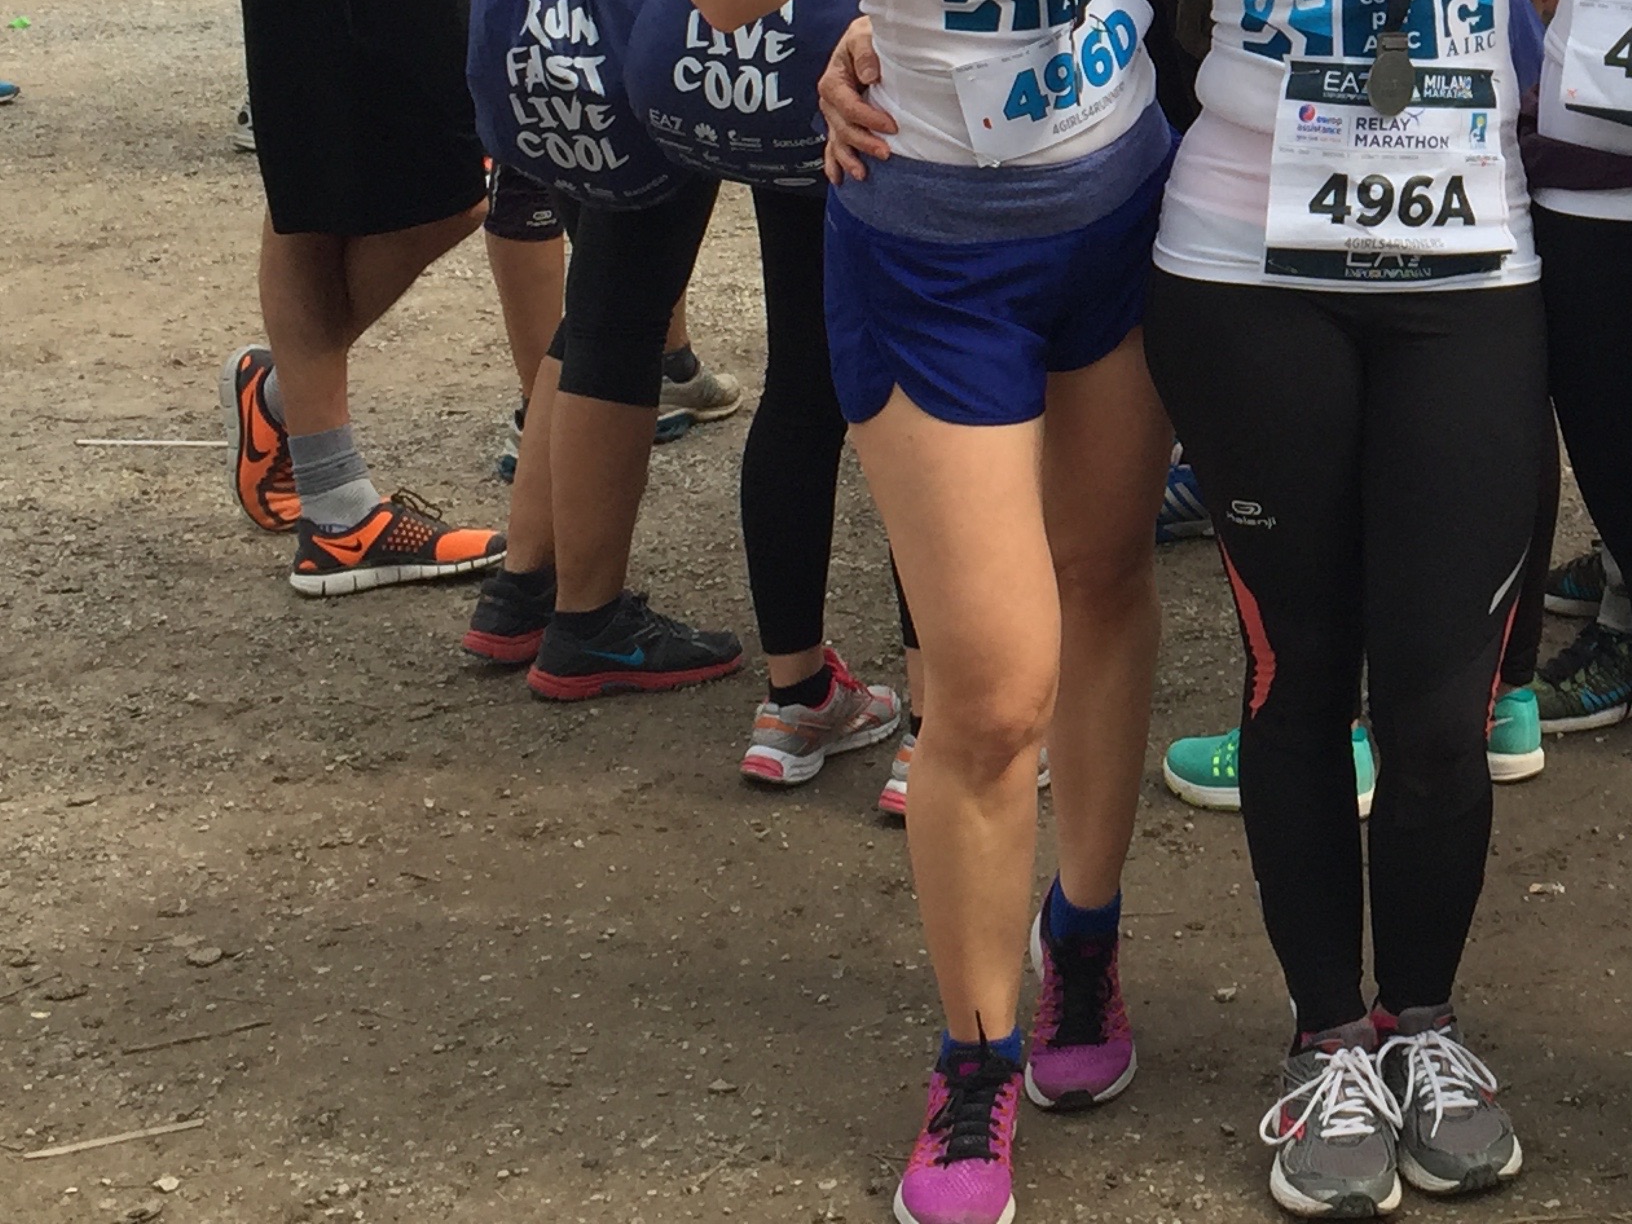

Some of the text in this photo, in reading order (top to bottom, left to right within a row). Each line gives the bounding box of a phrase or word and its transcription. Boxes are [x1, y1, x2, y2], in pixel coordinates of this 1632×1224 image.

[1446, 30, 1497, 58] AIRC
[506, 44, 607, 98] FAST
[673, 55, 793, 114] COOL
[1002, 9, 1138, 122] 496D
[508, 93, 616, 131] LIVE
[649, 108, 683, 131] EA7
[1356, 116, 1411, 131] RELAY
[516, 130, 630, 173] COOL
[1354, 133, 1450, 149] MARATHON
[1308, 172, 1476, 227] 496A
